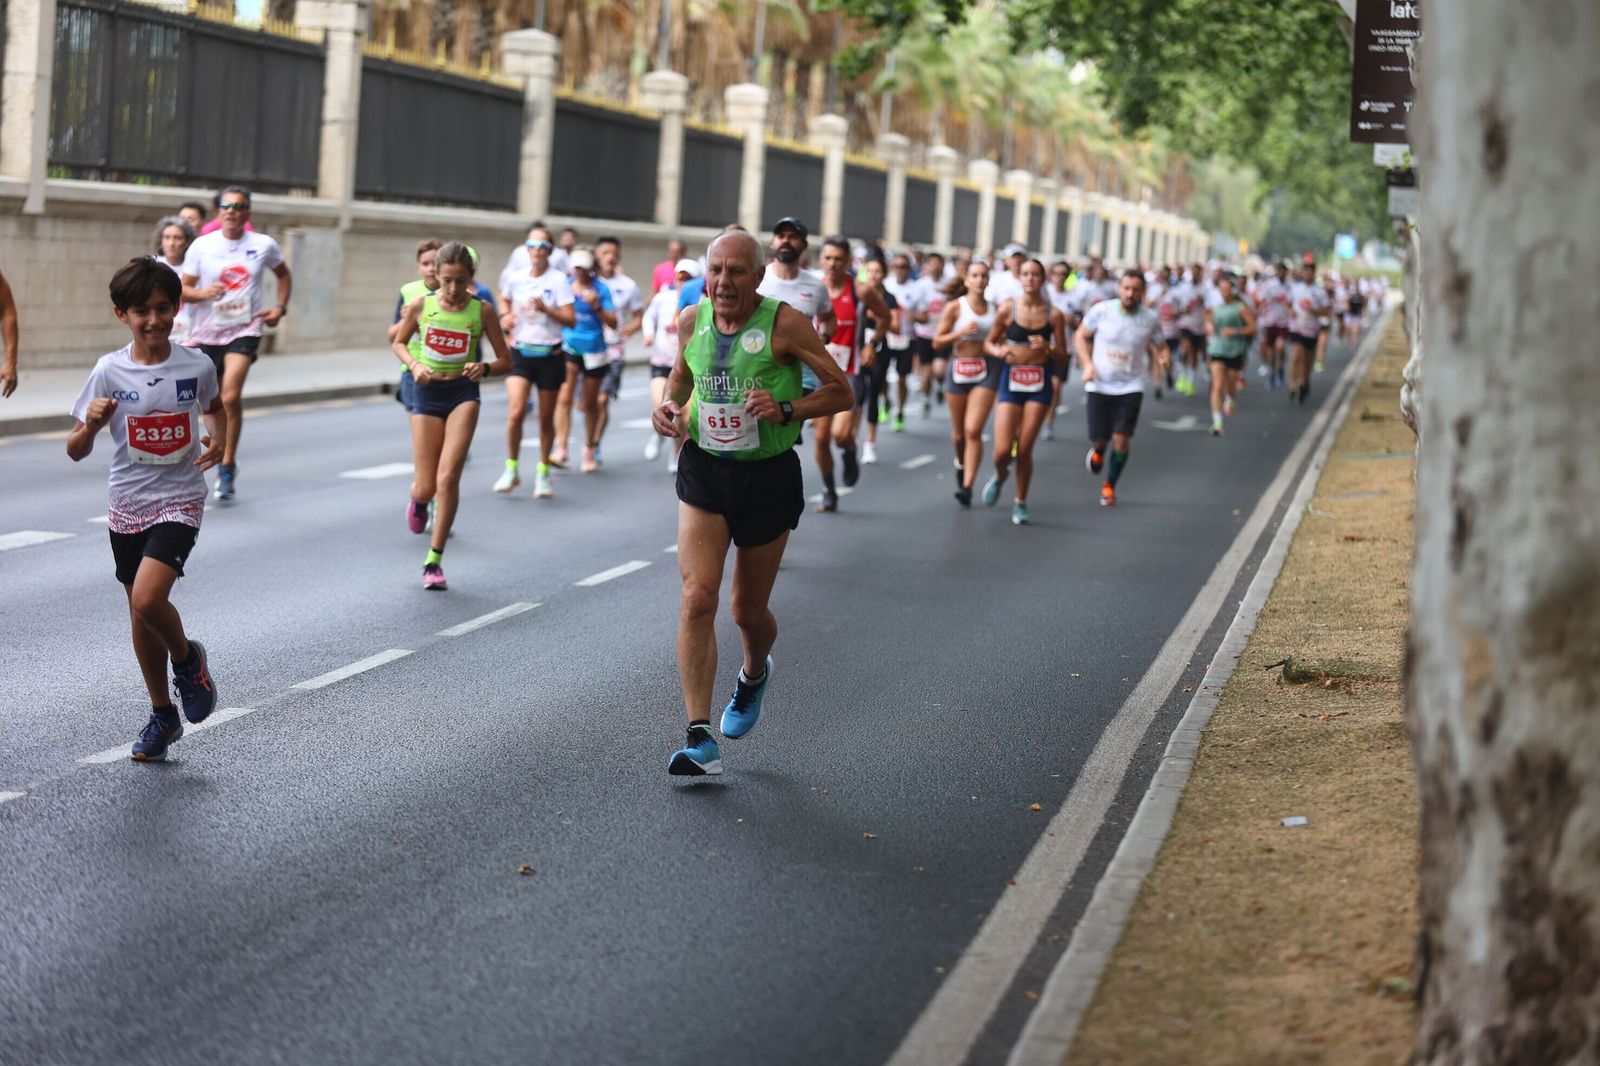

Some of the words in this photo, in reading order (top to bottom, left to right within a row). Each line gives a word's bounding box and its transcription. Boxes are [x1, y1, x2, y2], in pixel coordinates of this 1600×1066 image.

[177, 389, 195, 401] AXA
[708, 416, 741, 429] 615
[135, 425, 185, 441] 2328
